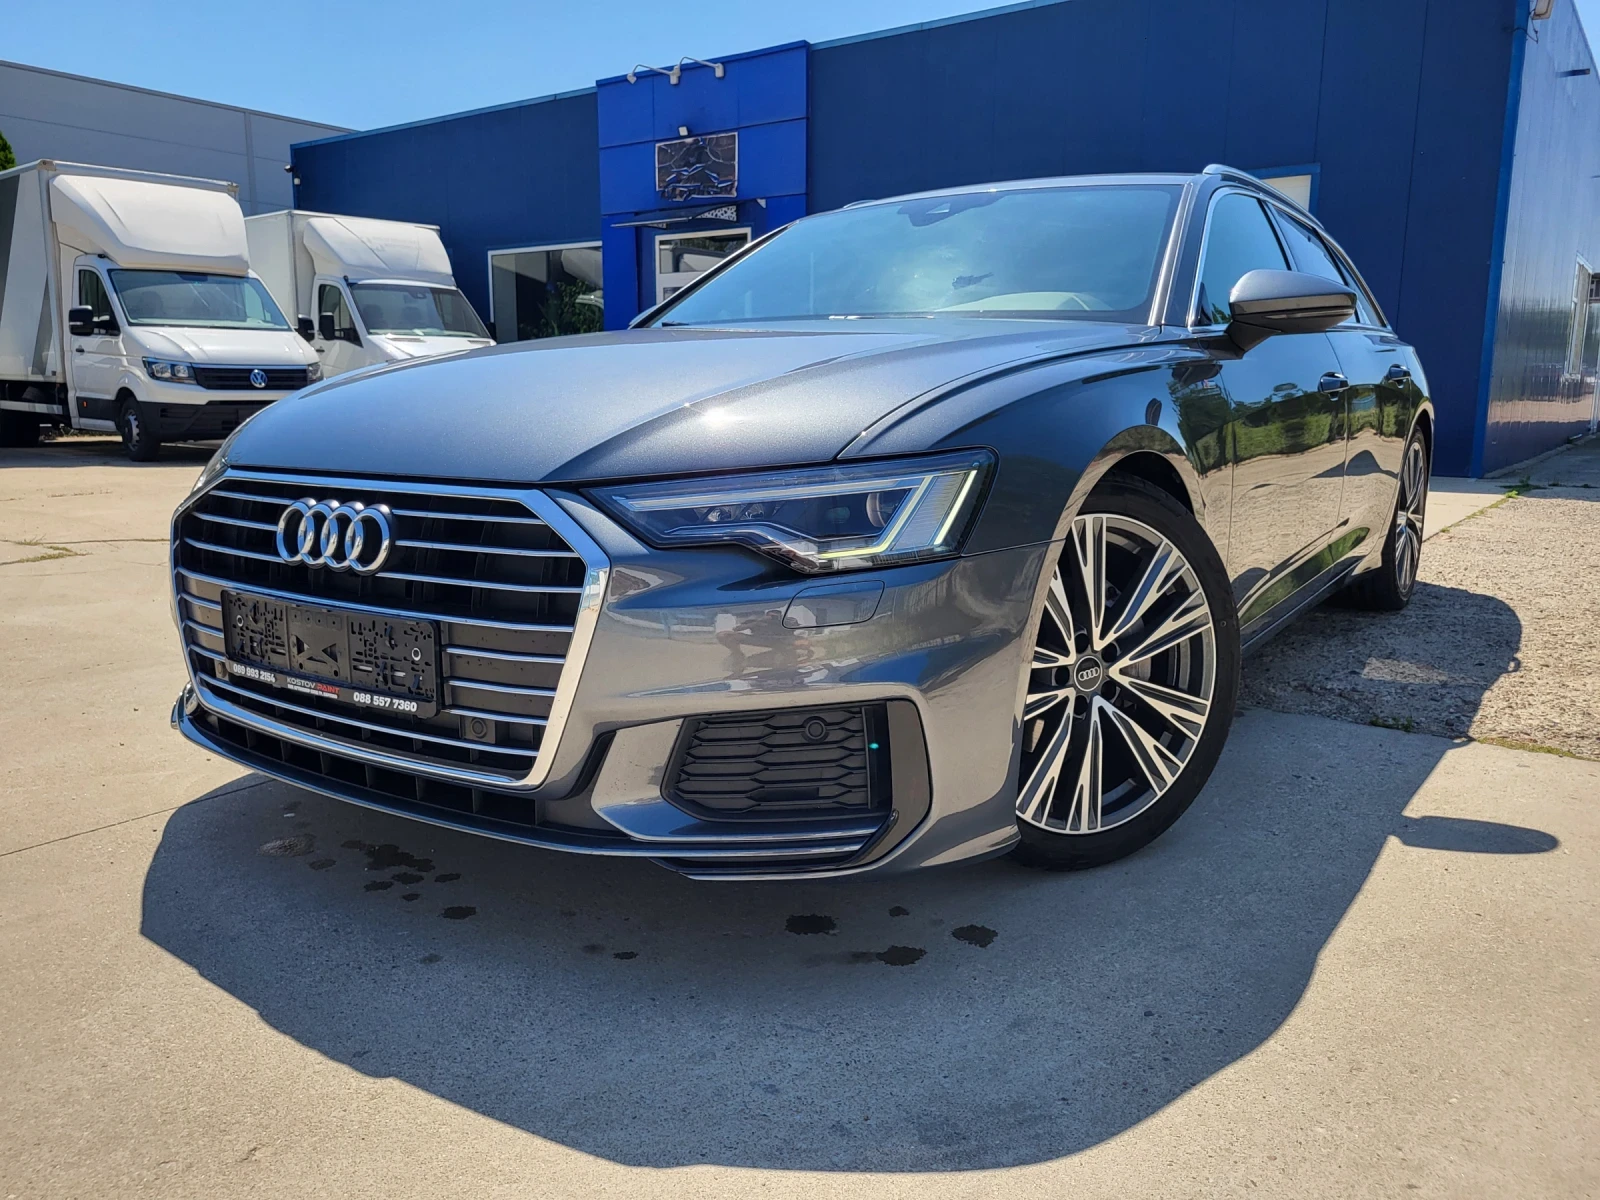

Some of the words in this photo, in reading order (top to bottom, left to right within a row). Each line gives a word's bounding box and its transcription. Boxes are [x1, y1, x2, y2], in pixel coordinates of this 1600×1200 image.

[233, 663, 246, 675] 089
[286, 676, 316, 689] KOSTOV
[317, 682, 340, 694] PAINT
[353, 691, 371, 704] 088
[372, 695, 391, 707] 557
[392, 699, 417, 712] 7360
